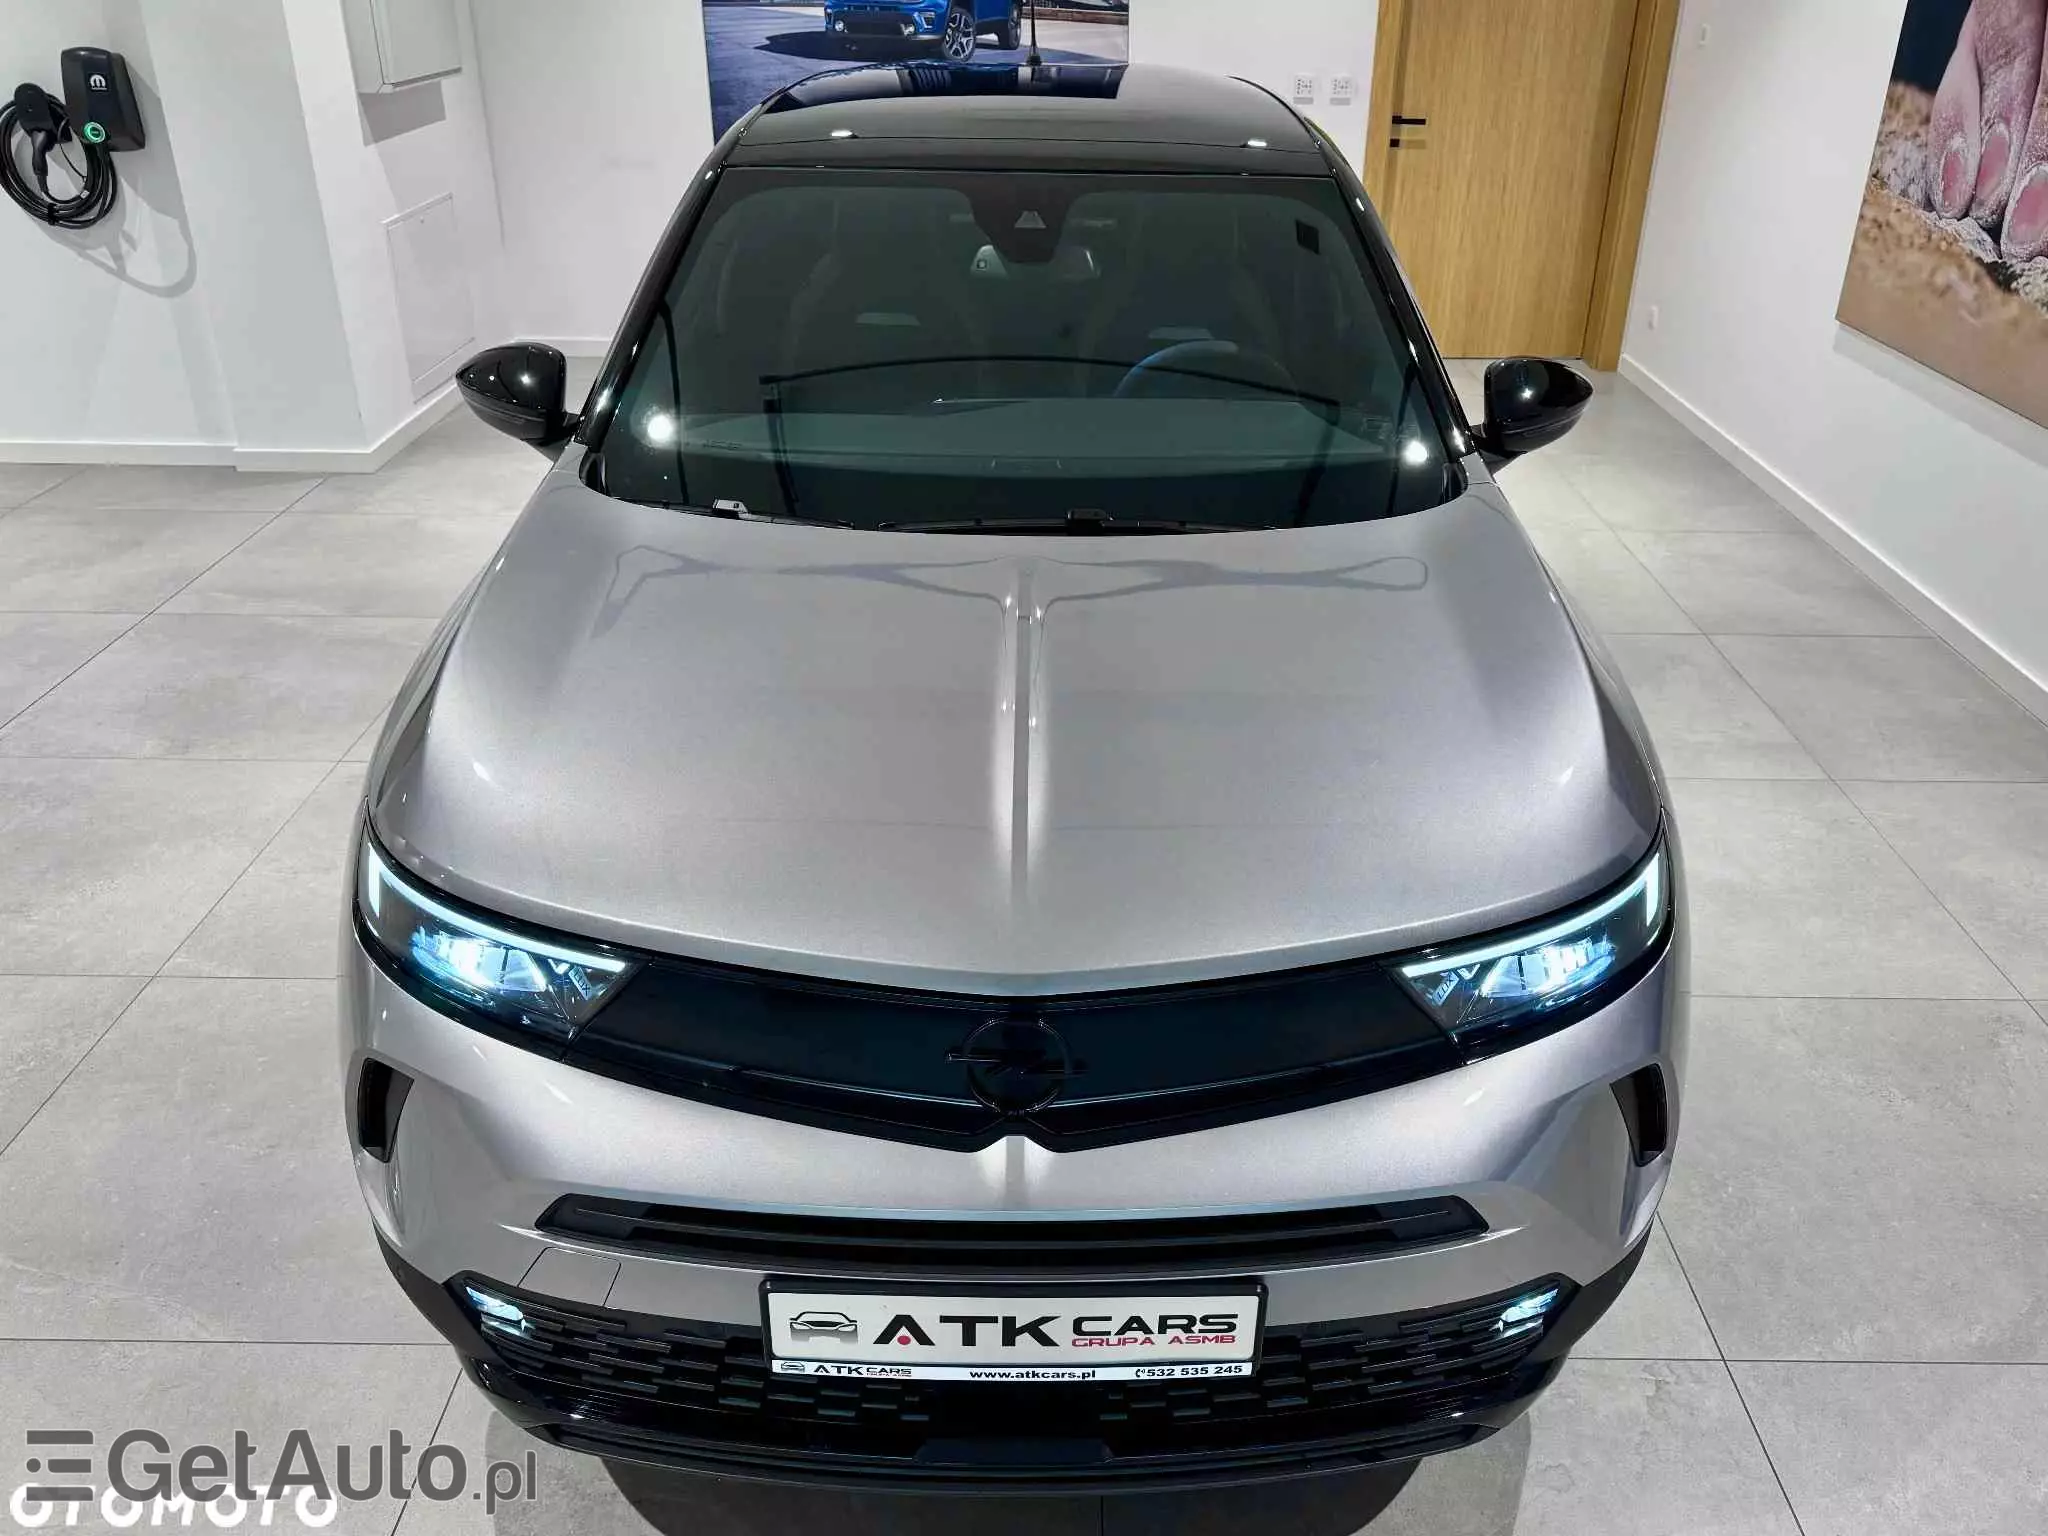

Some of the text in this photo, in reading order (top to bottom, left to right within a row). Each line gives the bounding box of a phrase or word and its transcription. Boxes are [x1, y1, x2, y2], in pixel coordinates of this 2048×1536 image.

[873, 1313, 1238, 1347] ATK CARS
[1072, 1335, 1236, 1347] GRUPA ASMB
[814, 1364, 864, 1376] ATK
[866, 1367, 912, 1375] CARS
[969, 1370, 1096, 1380] www.atkcars.pl
[1146, 1365, 1243, 1378] 532 535 245
